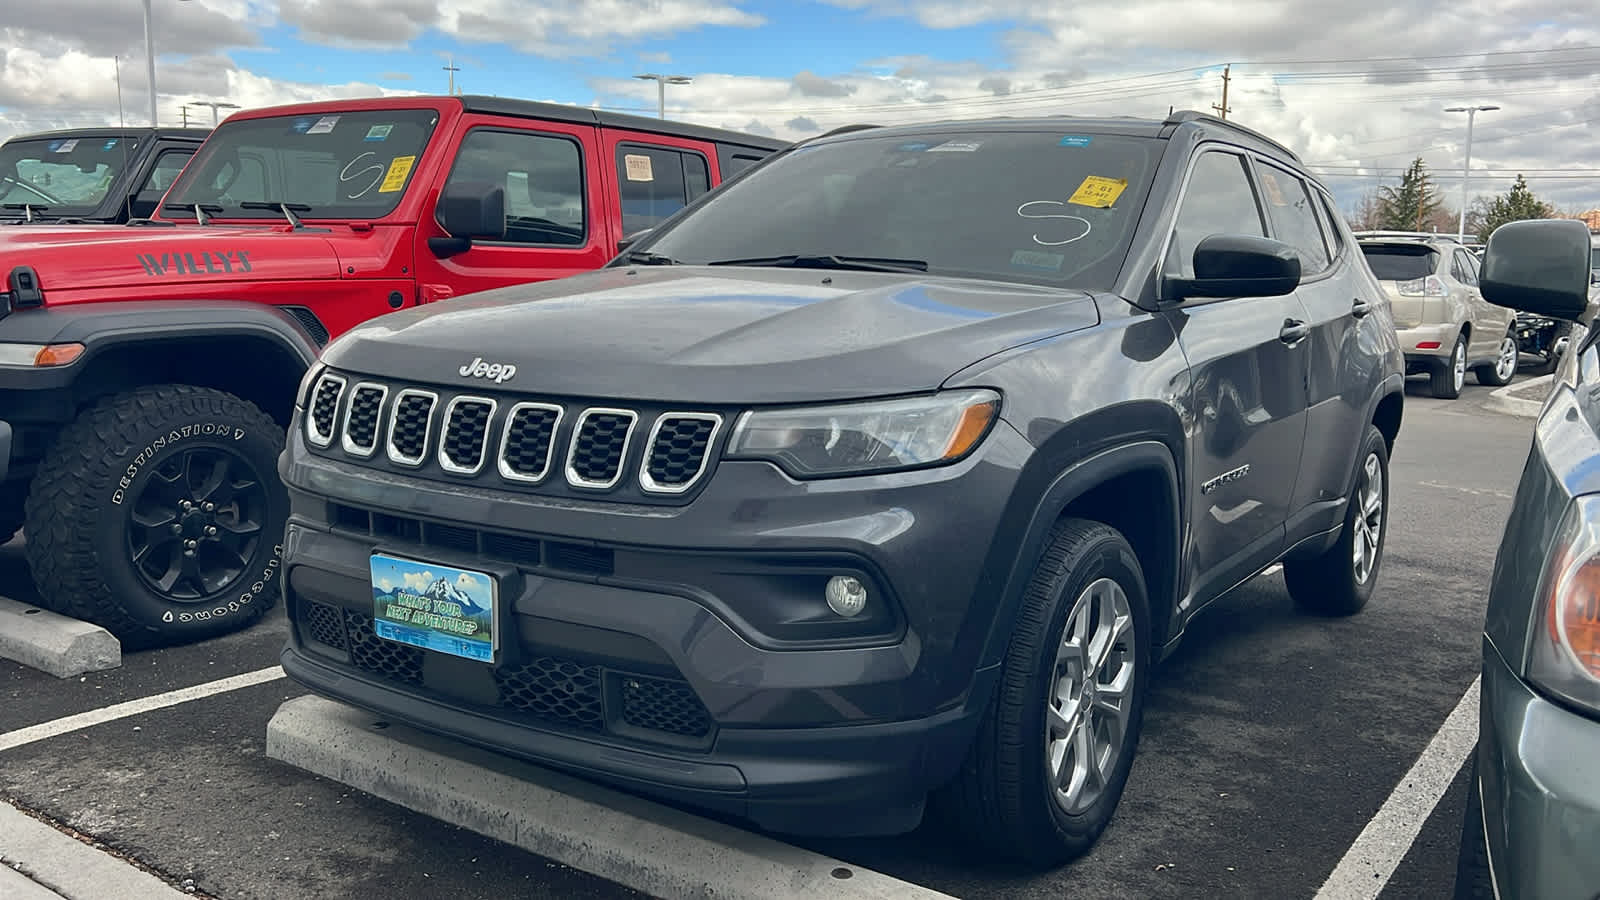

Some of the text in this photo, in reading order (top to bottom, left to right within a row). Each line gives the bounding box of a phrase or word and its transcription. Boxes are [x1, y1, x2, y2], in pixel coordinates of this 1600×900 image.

[340, 151, 385, 199] S
[1017, 200, 1092, 246] S
[136, 250, 252, 276] WILLYS
[459, 357, 516, 384] Jeep
[112, 423, 230, 505] DESTINATION
[386, 604, 477, 635] NEXT ADVENTURE?
[398, 592, 462, 618] WHAT'S YOUR
